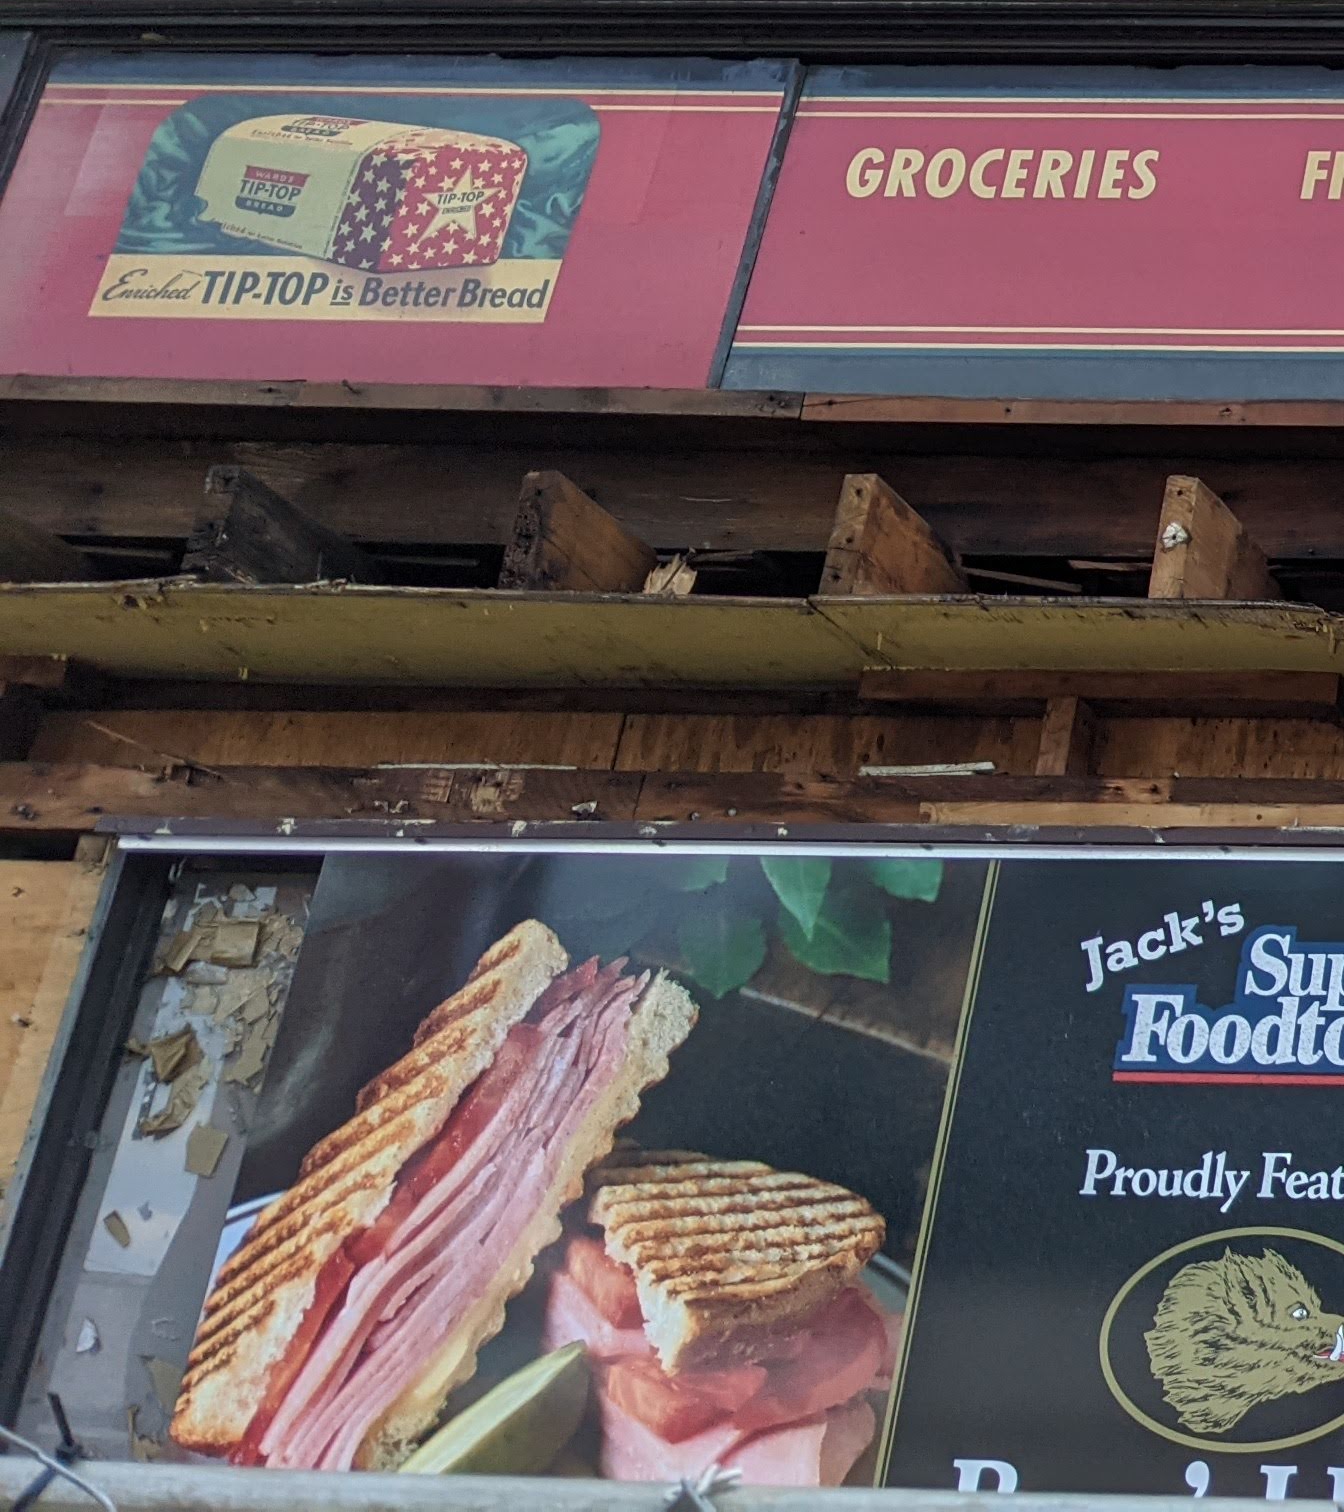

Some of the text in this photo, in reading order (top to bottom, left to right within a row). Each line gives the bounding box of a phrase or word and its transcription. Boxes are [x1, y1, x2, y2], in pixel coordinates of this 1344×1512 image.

[240, 179, 302, 201] TIP-TOP
[845, 147, 1160, 200] GROCERIES
[245, 198, 284, 213] BREAD
[437, 191, 485, 205] TIP-TOP
[102, 268, 550, 309] Enriched TIP-TOP is Better Bread
[1080, 899, 1246, 992] Jack's
[1079, 1148, 1250, 1213] Proudly
